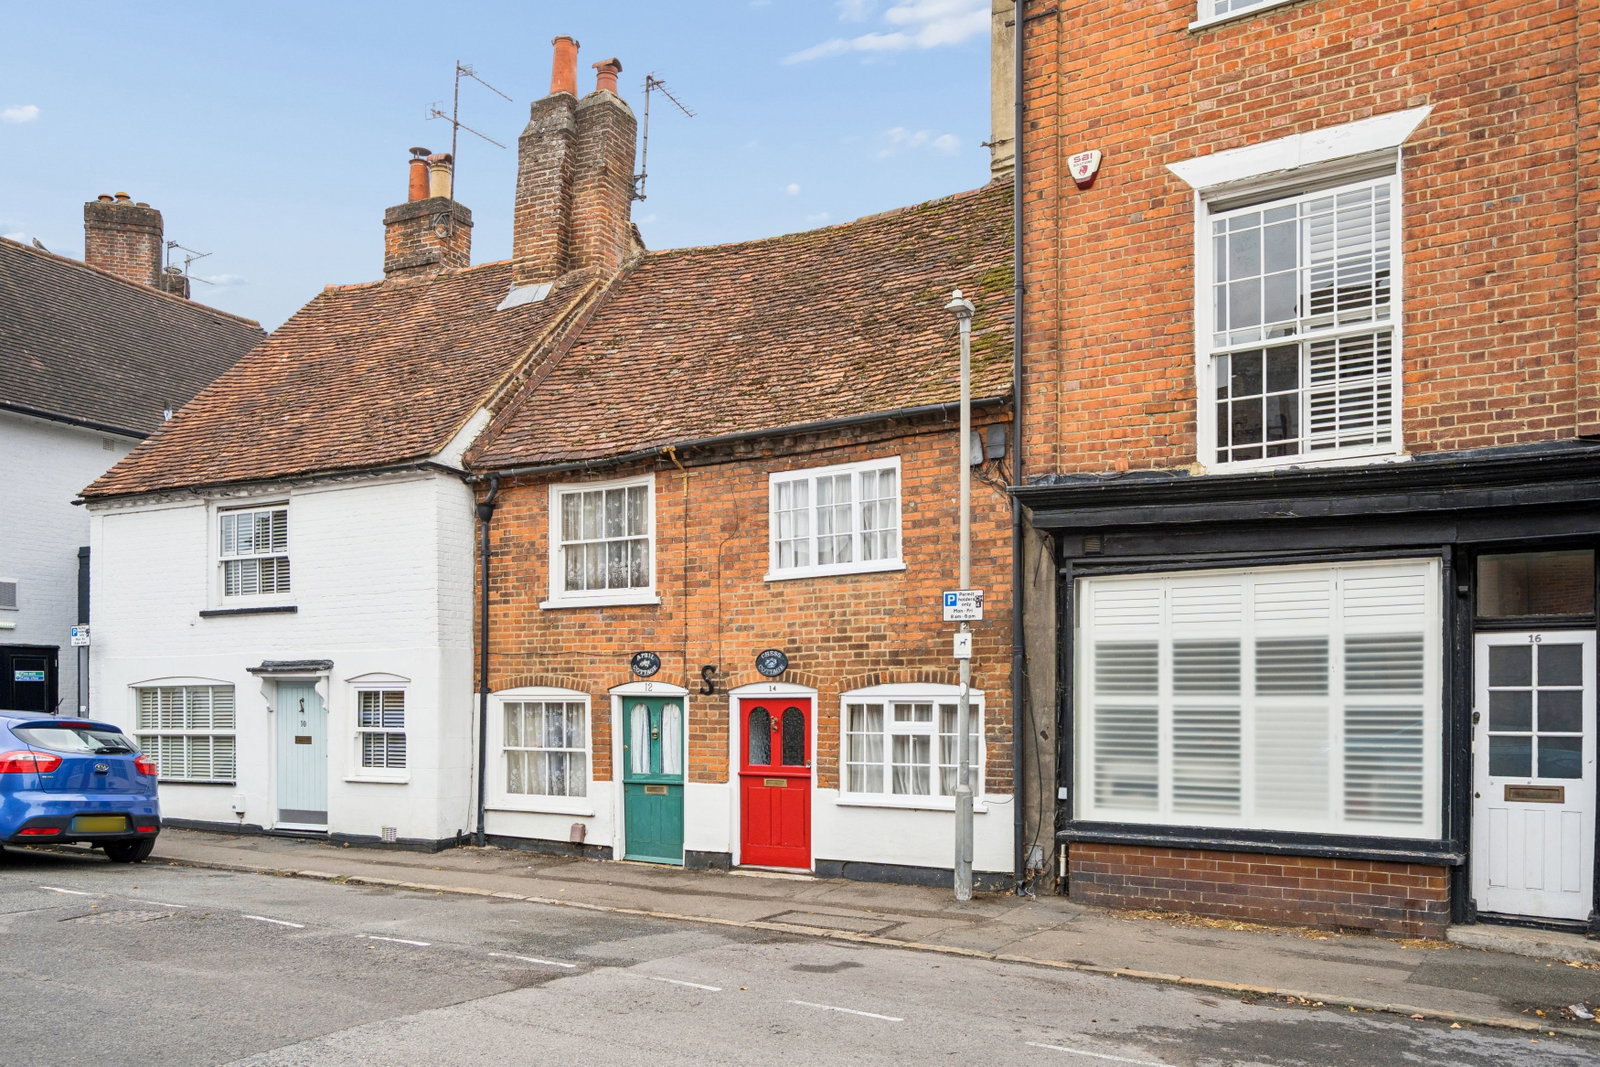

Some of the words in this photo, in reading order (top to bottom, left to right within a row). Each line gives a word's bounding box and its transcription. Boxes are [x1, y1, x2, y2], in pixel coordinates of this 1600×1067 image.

[947, 595, 956, 605] P
[1528, 633, 1542, 643] 16
[760, 650, 783, 659] CHESS
[632, 664, 658, 677] COTTAGE
[758, 664, 785, 675] COTTAGE
[644, 682, 653, 692] 12
